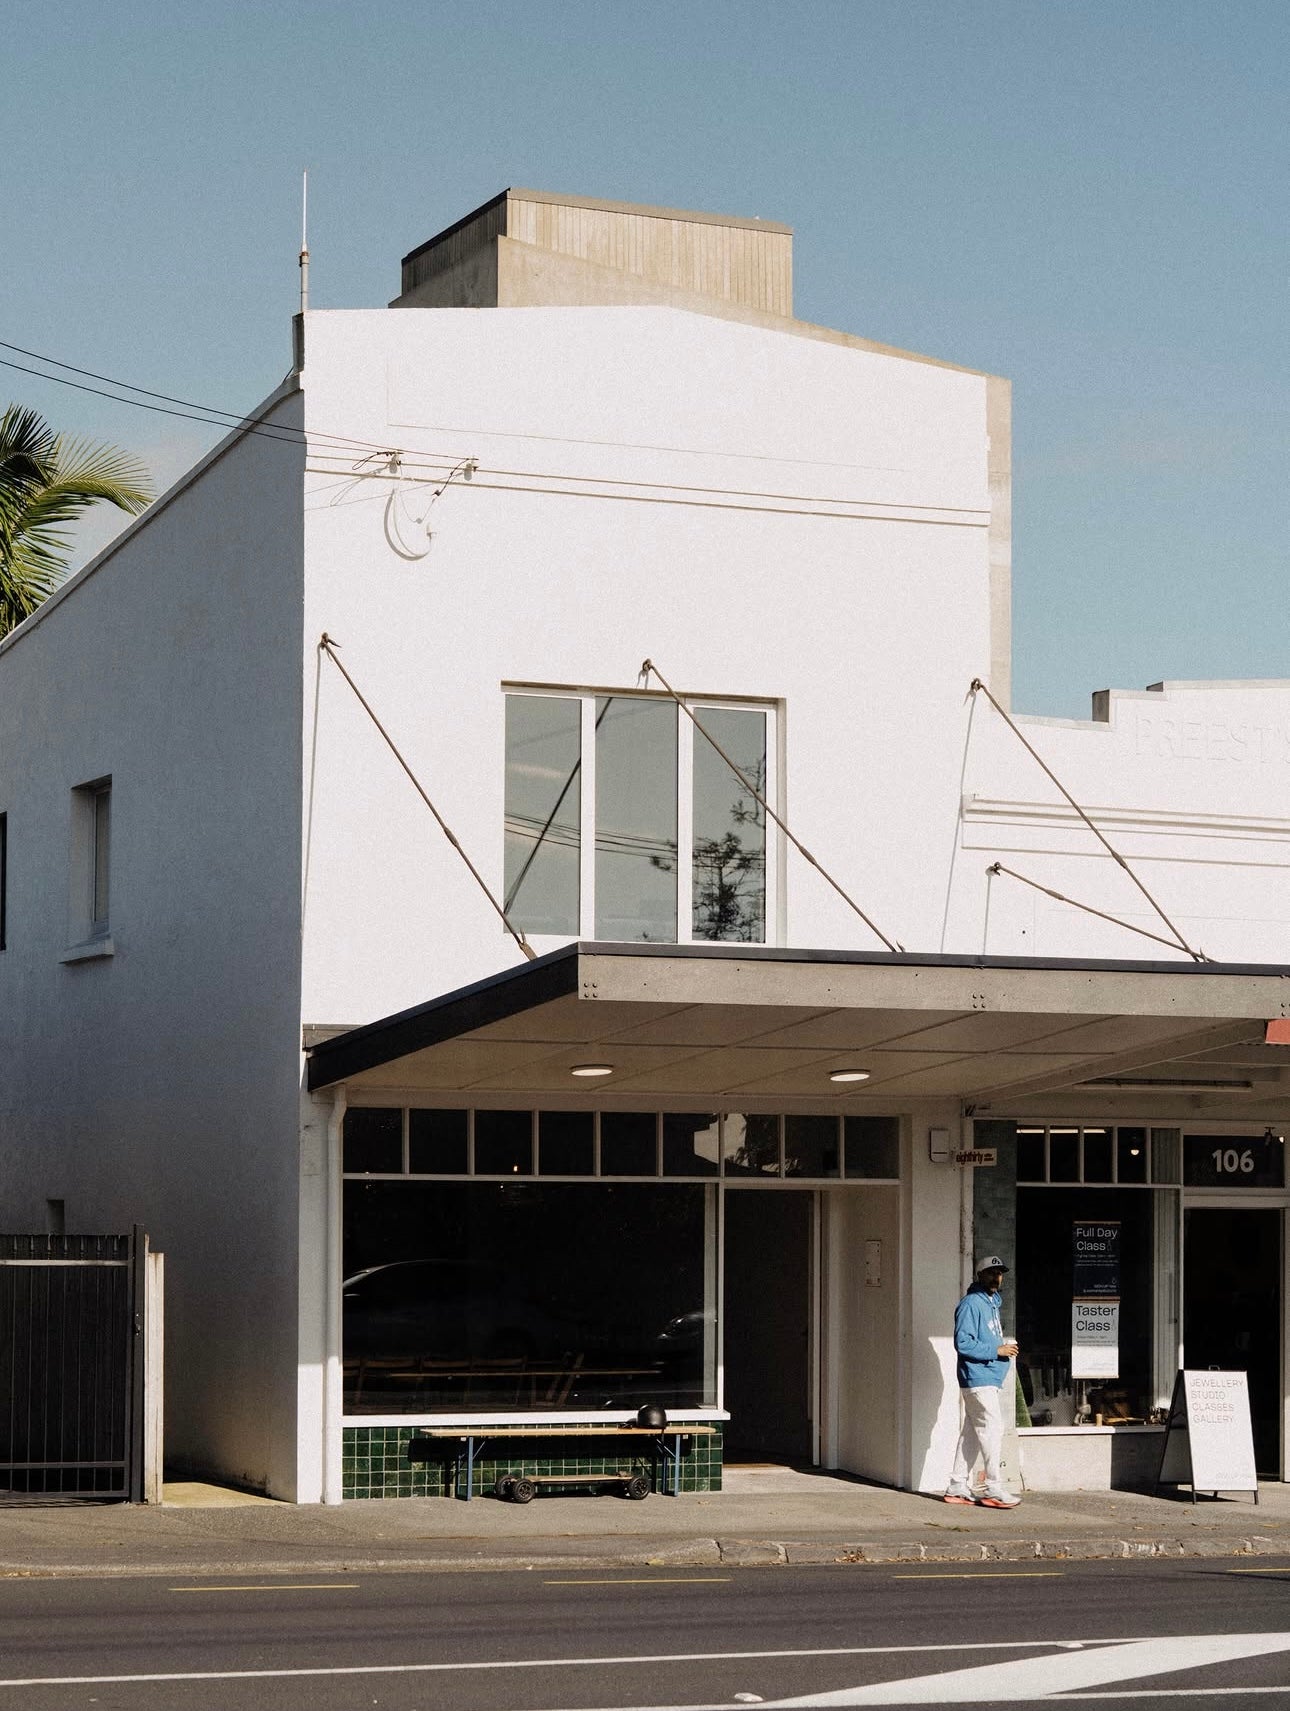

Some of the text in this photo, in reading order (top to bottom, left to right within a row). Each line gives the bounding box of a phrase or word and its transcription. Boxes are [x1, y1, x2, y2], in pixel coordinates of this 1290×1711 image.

[1212, 1149, 1255, 1173] 106
[1076, 1227, 1118, 1240] Full Day
[1076, 1240, 1106, 1251] Class
[1076, 1305, 1117, 1316] Taster
[1076, 1320, 1111, 1332] Class
[1190, 1379, 1244, 1388] JEWELLERY
[1191, 1390, 1226, 1400] STUDIO
[1192, 1402, 1234, 1412] CLASSES
[1193, 1414, 1234, 1424] GALLERY
